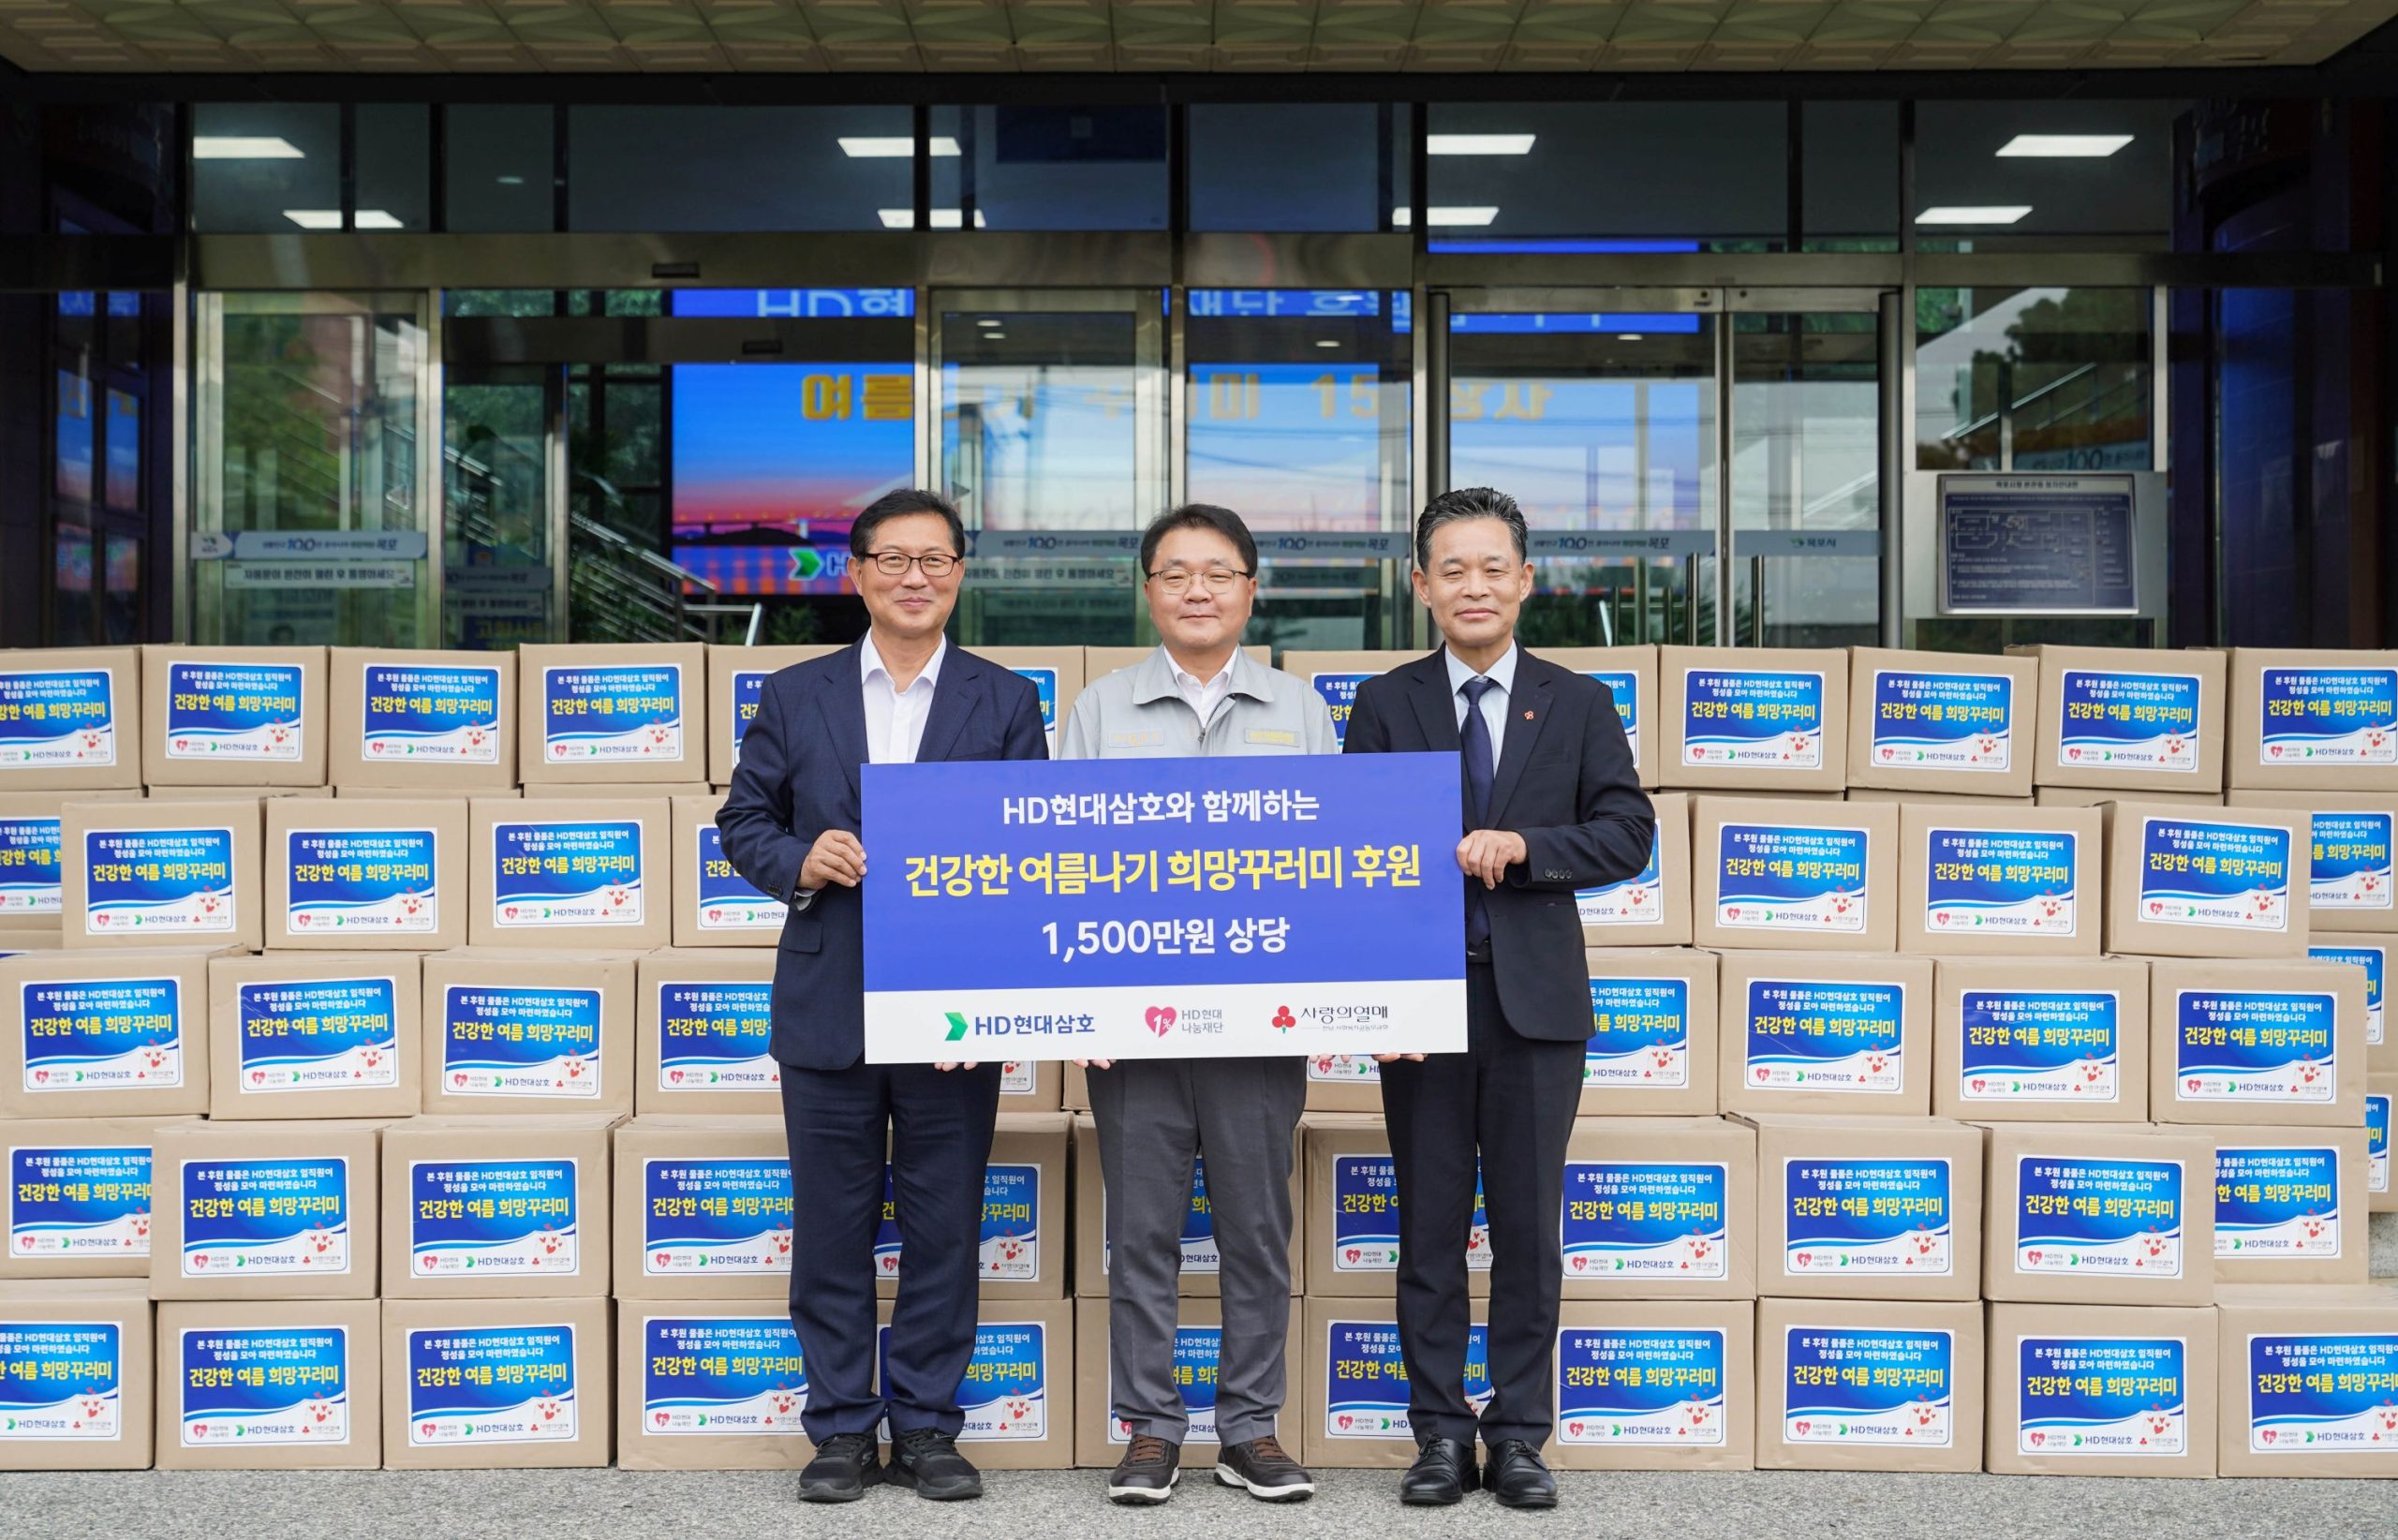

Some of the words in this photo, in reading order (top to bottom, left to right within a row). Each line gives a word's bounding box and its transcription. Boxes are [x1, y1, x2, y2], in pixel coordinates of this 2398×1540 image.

[175, 694, 210, 710] 건강한
[213, 695, 235, 711] 여름
[239, 696, 295, 712] 희망꾸러미
[552, 699, 588, 715] 건강한
[590, 698, 614, 714] 여름
[616, 697, 674, 713] 희망꾸러미
[1692, 702, 1728, 718] 건강한
[1731, 703, 1754, 718] 여름
[1757, 703, 1815, 720] 희망꾸러미
[2269, 700, 2305, 716] 건강한
[2308, 700, 2331, 716] 여름
[2334, 700, 2391, 716] 희망꾸러미
[2069, 703, 2105, 719] 건강한
[2108, 704, 2131, 720] 여름
[2134, 705, 2192, 723] 희망꾸러미
[1004, 792, 1195, 825] HD현대삼호와
[1202, 790, 1319, 822] 함께하는
[1951, 838, 1965, 847] 후원
[1991, 840, 2032, 849] HD현대삼호
[2035, 841, 2063, 850] 임직원이
[1957, 849, 1978, 858] 정성을
[295, 865, 334, 881] 건강한
[337, 865, 363, 881] 여름
[366, 864, 428, 881] 희망꾸러미
[906, 853, 1013, 896] 건강한
[1019, 851, 1158, 894] 여름나기
[1168, 847, 1341, 891] 희망꾸러미
[1352, 845, 1420, 887] 후원
[1935, 863, 1975, 881] 건강한
[1977, 865, 2002, 881] 여름
[2006, 866, 2068, 883] 희망꾸러미
[2150, 853, 2189, 871] 건강한
[2192, 856, 2216, 874] 여름
[2220, 858, 2282, 879] 희망꾸러미
[1985, 916, 2028, 925] HD현대삼호
[1043, 919, 1215, 963] 1,500만원
[1224, 917, 1290, 954] 상당
[1182, 1010, 1221, 1020] HD현대
[1301, 1006, 1387, 1023] 사랑의열매
[31, 1017, 72, 1036] 건강한
[75, 1016, 102, 1034] 여름
[105, 1014, 171, 1033] 희망꾸러미
[452, 1022, 494, 1040] 건강한
[497, 1023, 524, 1041] 여름
[526, 1024, 593, 1043] 희망꾸러미
[976, 1014, 1095, 1035] HD현대삼호
[1182, 1022, 1223, 1033] 나눔재단
[1755, 1016, 1796, 1034] 건강한
[1799, 1017, 1826, 1035] 여름
[1829, 1018, 1895, 1038] 희망꾸러미
[2185, 1027, 2227, 1045] 건강한
[2230, 1028, 2257, 1046] 여름
[2260, 1029, 2327, 1047] 희망꾸러미
[437, 1172, 452, 1181] 후원
[481, 1171, 527, 1180] HD현대삼호
[530, 1170, 562, 1179] 임직원이
[1812, 1169, 1828, 1178] 후원
[1856, 1169, 1902, 1178] HD현대삼호
[1903, 1169, 1936, 1178] 임직원이
[444, 1183, 468, 1192] 정성을
[470, 1183, 486, 1192] 모아
[1818, 1180, 1842, 1191] 정성을
[1844, 1181, 1861, 1190] 모아
[420, 1200, 464, 1219] 건강한
[467, 1199, 495, 1218] 여름
[498, 1198, 569, 1217] 희망꾸러미
[1342, 1194, 1386, 1212] 건강한
[1794, 1197, 1838, 1216] 건강한
[1842, 1197, 1869, 1216] 여름
[1873, 1197, 1942, 1217] 희망꾸러미
[478, 1256, 525, 1266] HD현대삼호
[1851, 1255, 1899, 1265] HD현대삼호
[1813, 1338, 1828, 1347] 후원
[1858, 1340, 1902, 1349] HD현대삼호
[1905, 1340, 1938, 1350] 임직원이
[1819, 1350, 1843, 1359] 정성을
[1845, 1351, 1862, 1359] 모아
[190, 1368, 233, 1386] 건강한
[237, 1368, 265, 1386] 여름
[269, 1365, 338, 1385] 희망꾸러미
[966, 1362, 1036, 1382] 희망꾸러미
[1337, 1360, 1380, 1379] 건강한
[1567, 1367, 1610, 1385] 건강한
[1614, 1368, 1642, 1386] 여름
[1646, 1368, 1715, 1386] 희망꾸러미
[1794, 1366, 1838, 1385] 건강한
[1842, 1367, 1870, 1386] 여름
[1873, 1368, 1944, 1387] 희망꾸러미
[2028, 1376, 2071, 1396] 건강한
[2075, 1377, 2103, 1396] 여름
[2107, 1377, 2176, 1397] 희망꾸러미
[1851, 1425, 1898, 1435] HD현대삼호
